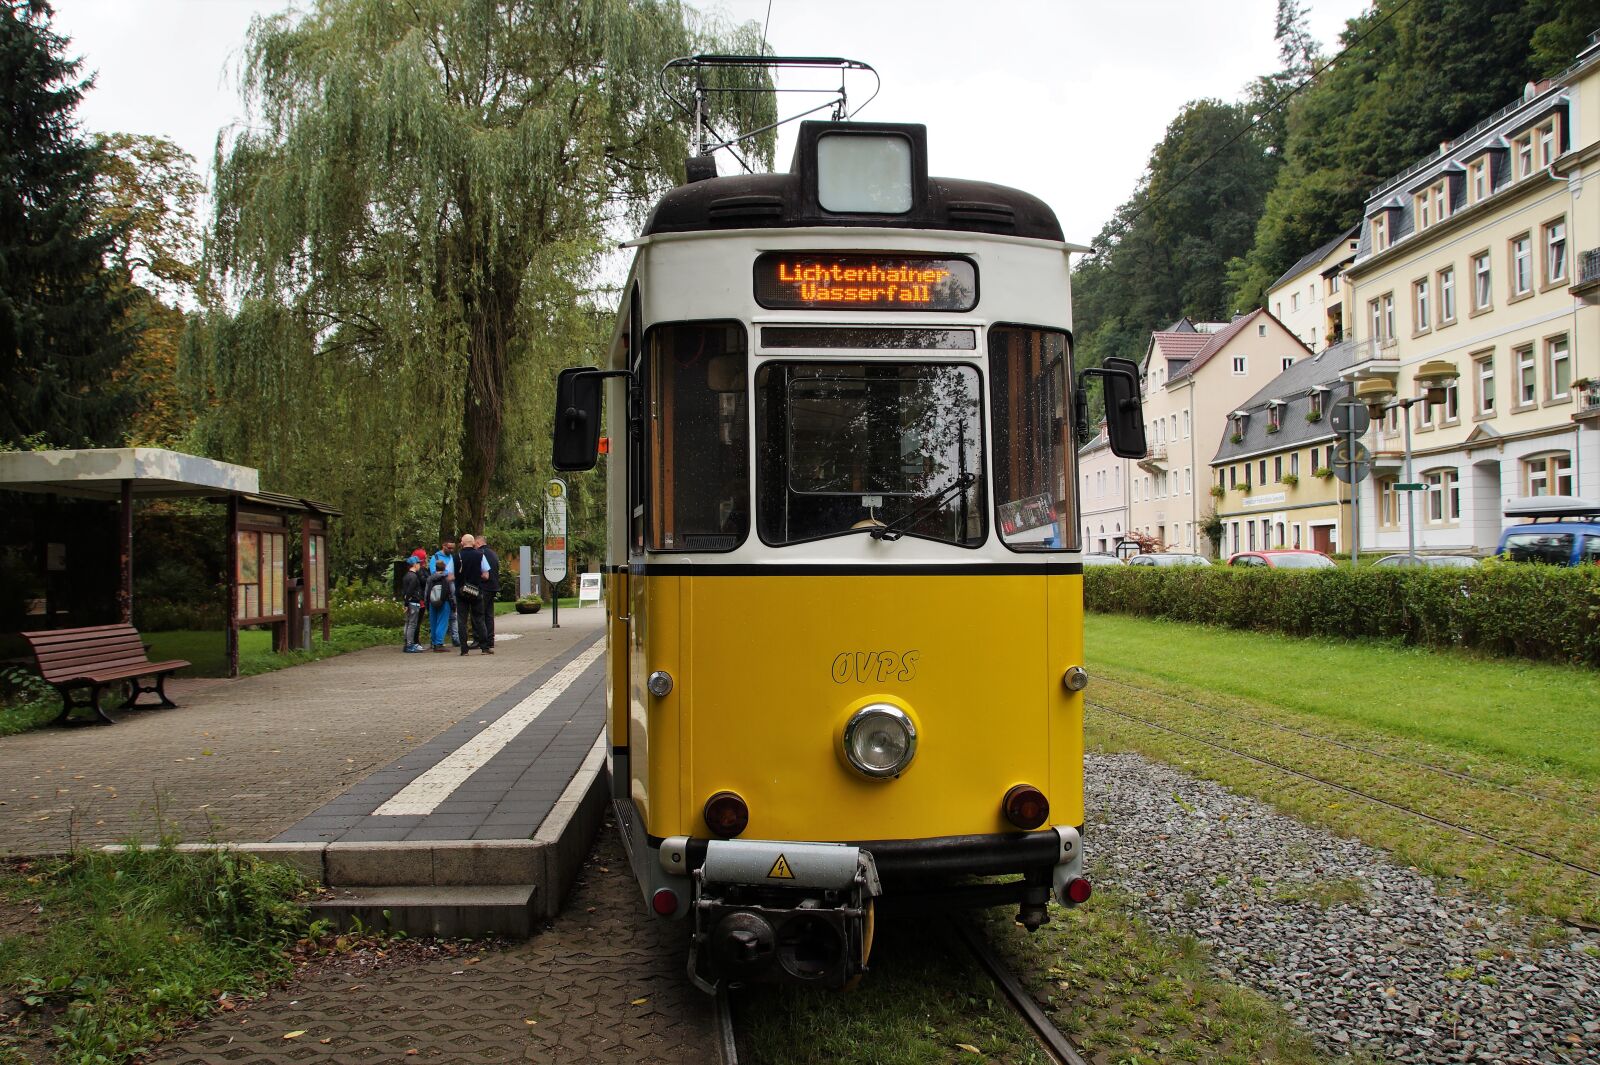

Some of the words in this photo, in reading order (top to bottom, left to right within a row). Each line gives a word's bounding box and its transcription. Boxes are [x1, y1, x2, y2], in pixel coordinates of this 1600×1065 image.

[779, 264, 949, 283] Lichtenhainer
[801, 285, 930, 302] Wasserfall
[832, 650, 920, 684] OVPS
